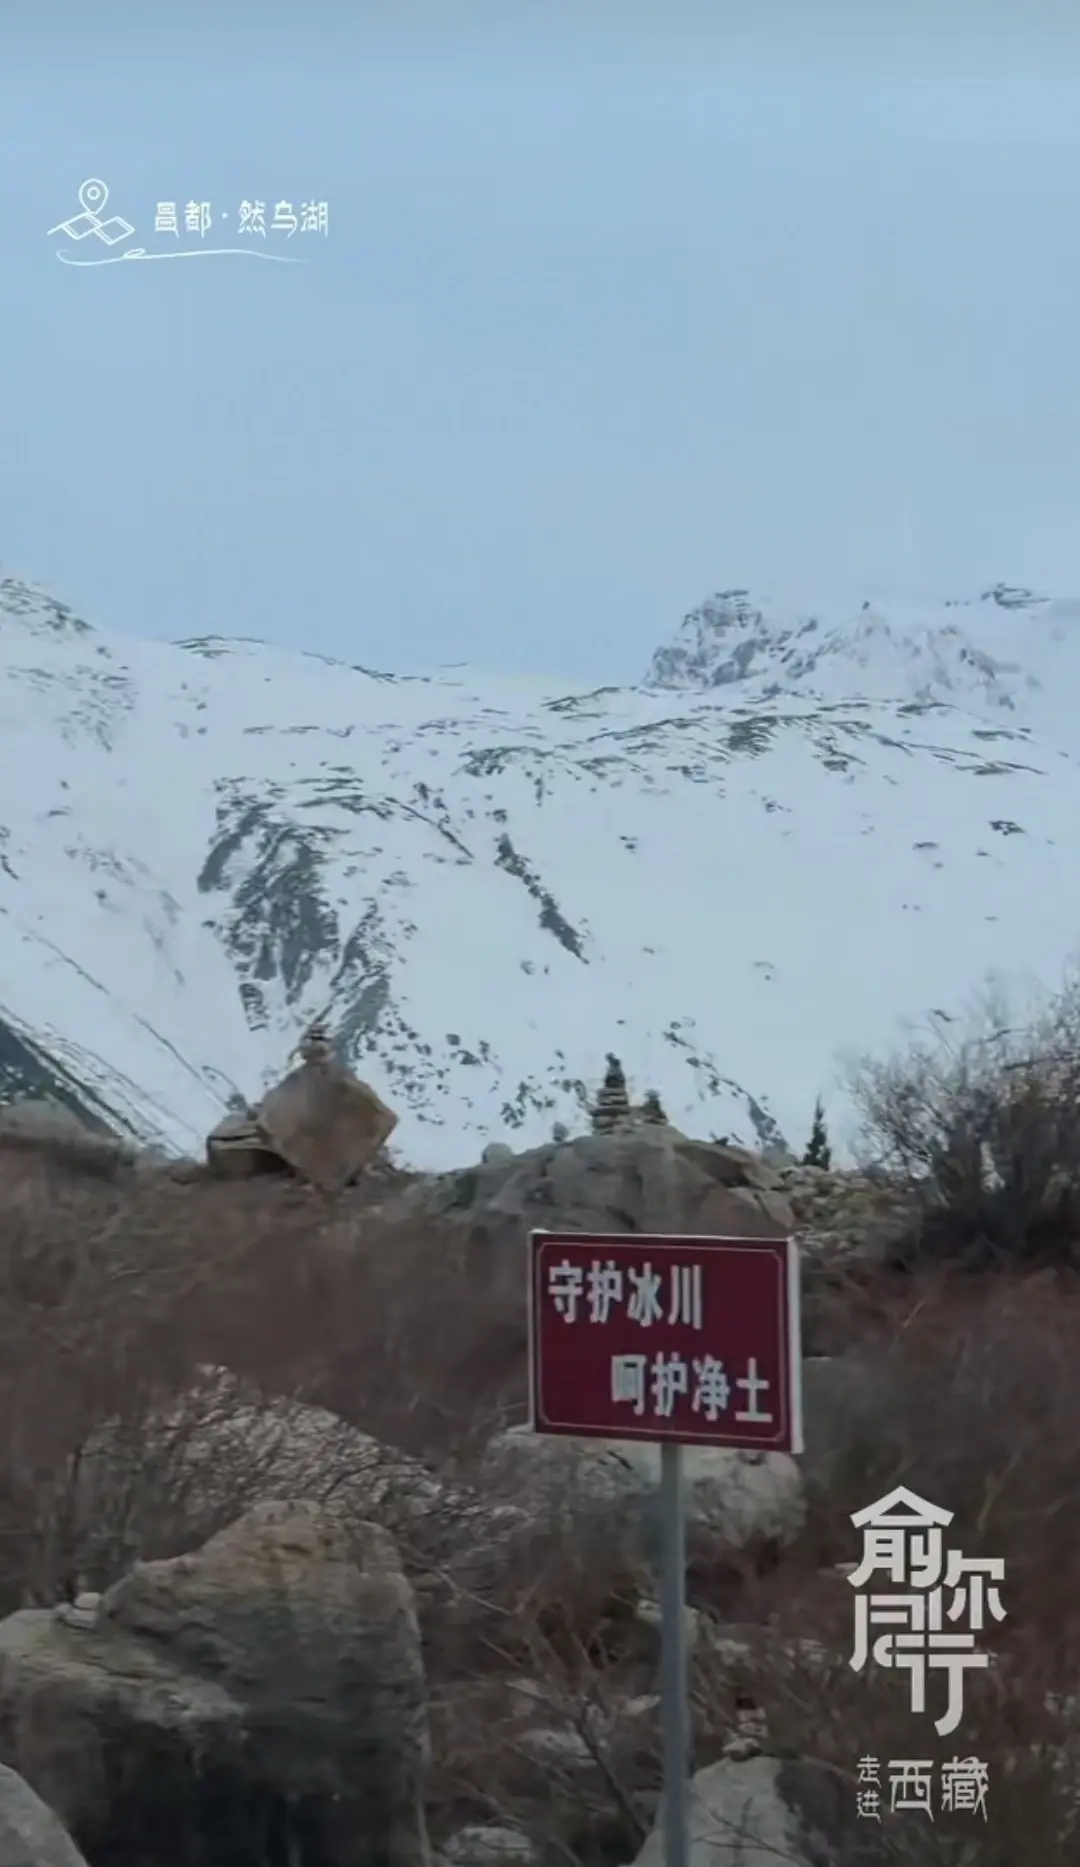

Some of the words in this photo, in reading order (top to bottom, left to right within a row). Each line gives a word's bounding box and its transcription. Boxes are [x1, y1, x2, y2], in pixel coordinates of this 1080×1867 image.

[548, 1259, 702, 1330] 守护冰川
[611, 1351, 773, 1423] 呵护净土
